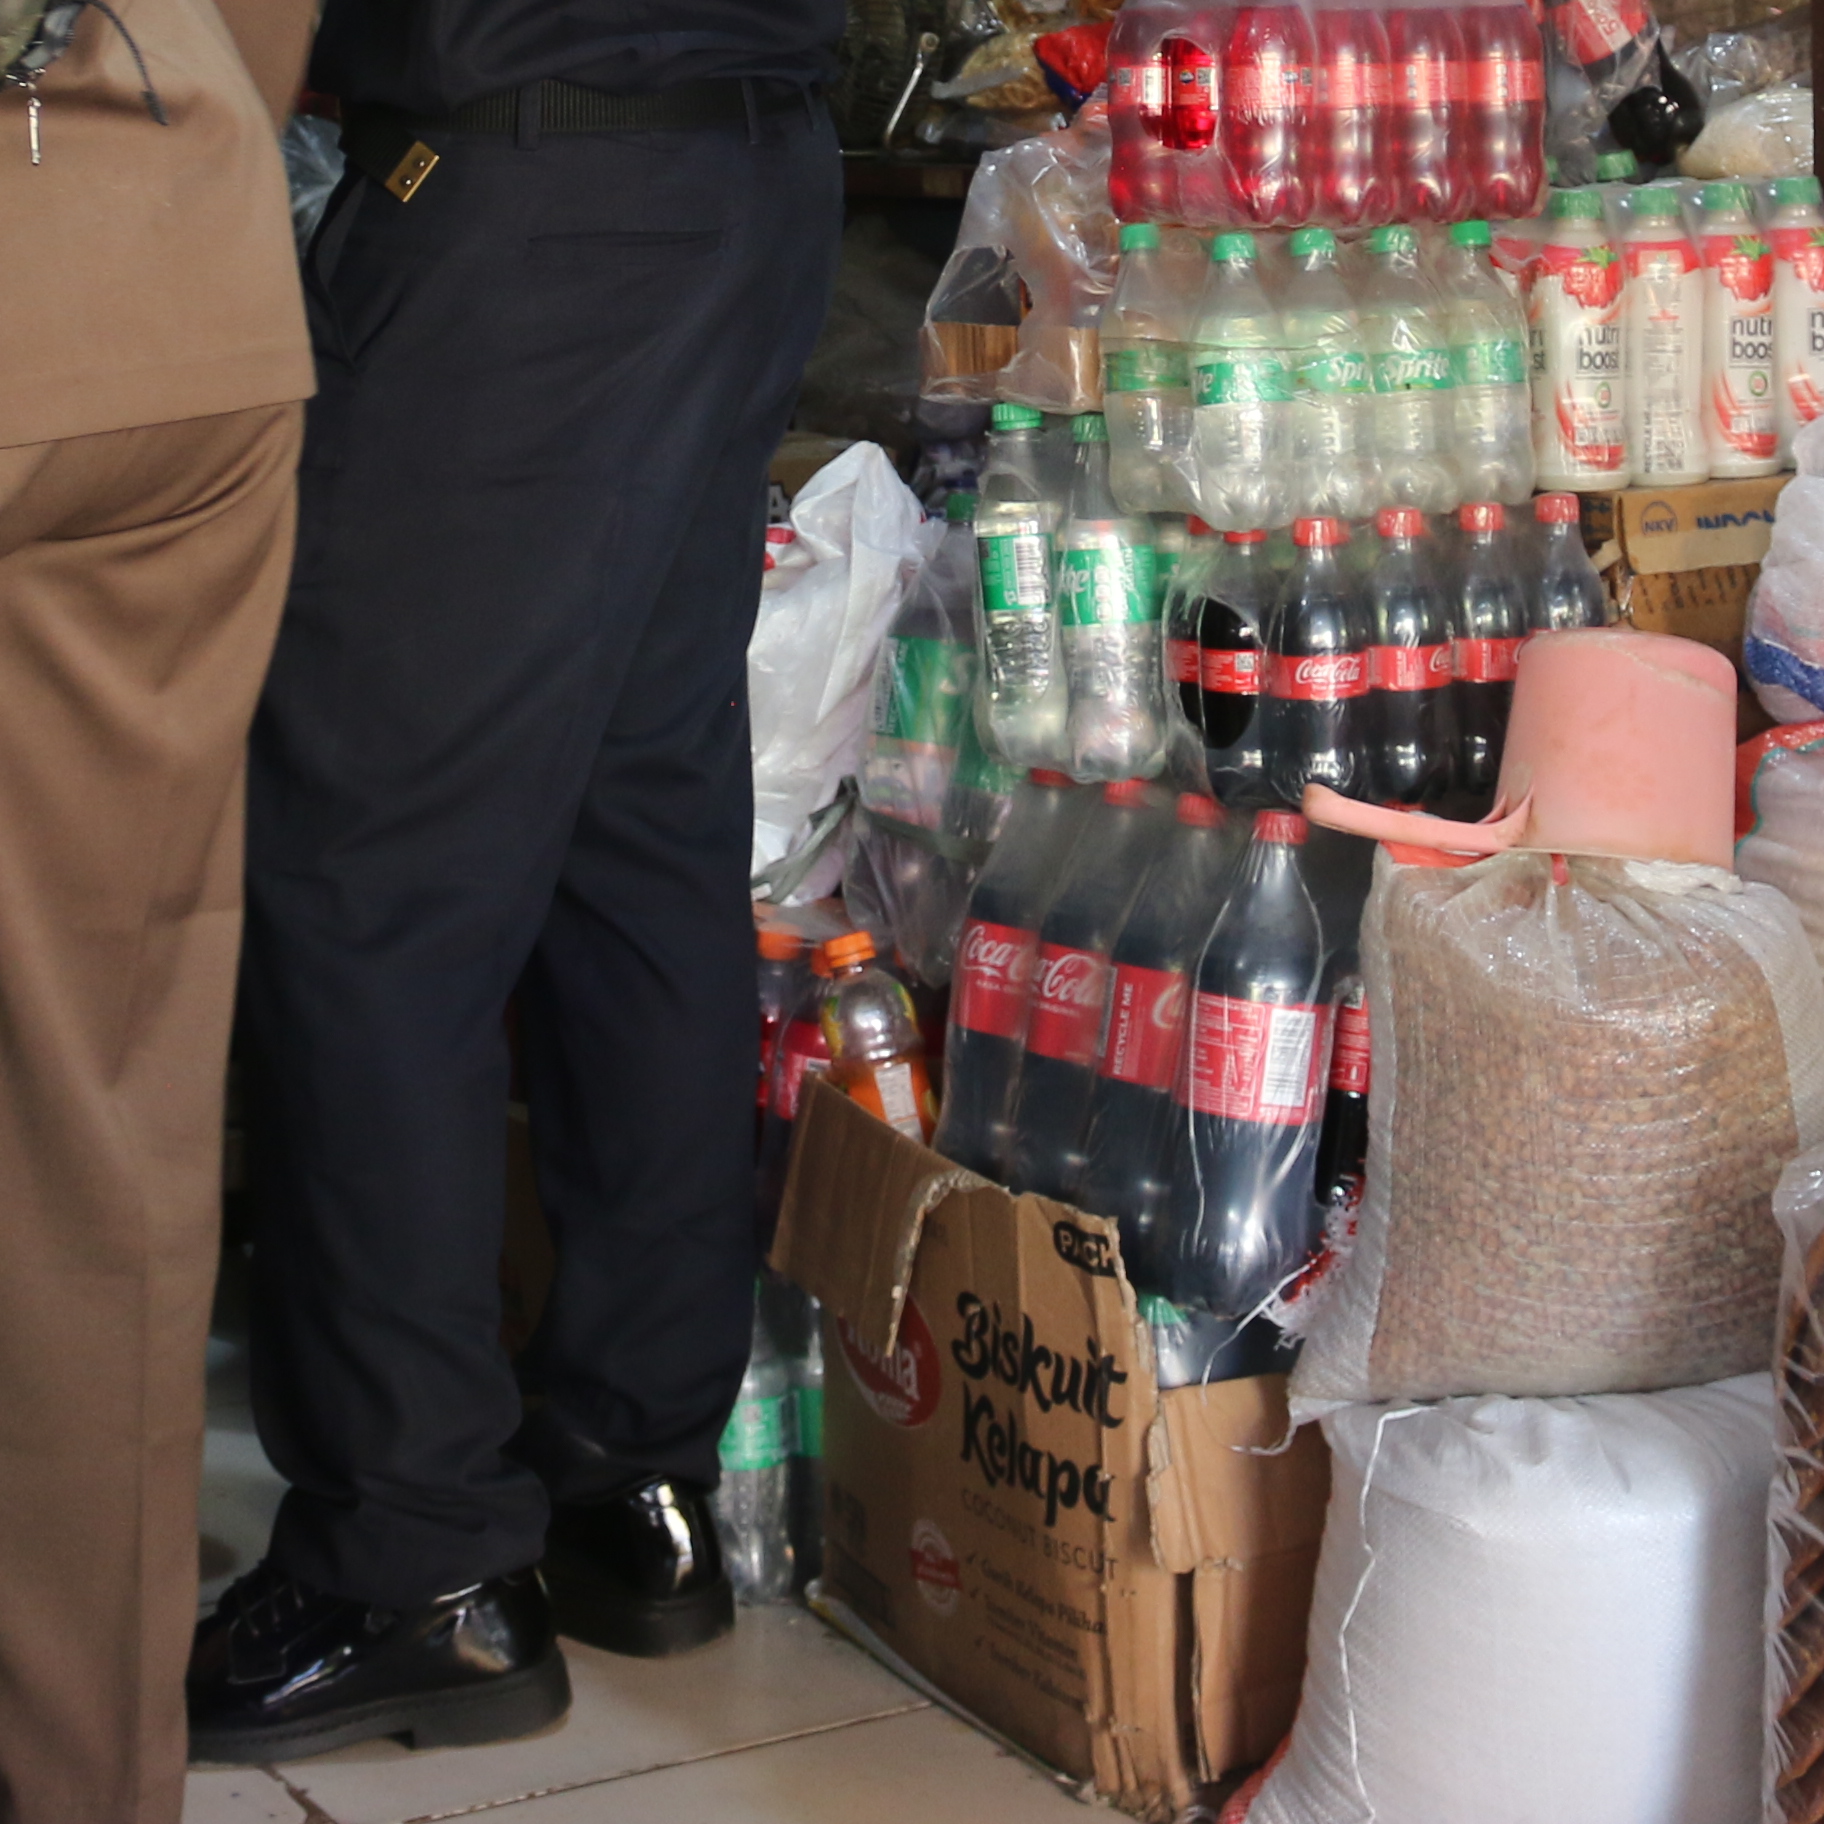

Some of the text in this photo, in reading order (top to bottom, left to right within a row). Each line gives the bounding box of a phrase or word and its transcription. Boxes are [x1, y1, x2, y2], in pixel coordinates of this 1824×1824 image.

[1296, 657, 1360, 685] Coca-Cola
[1112, 982, 1134, 1074] RECYCLE ME
[951, 1290, 1128, 1429] Biskuit
[960, 1381, 1116, 1528] Kelapa
[961, 1488, 1118, 1581] COCONUT BISCUT
